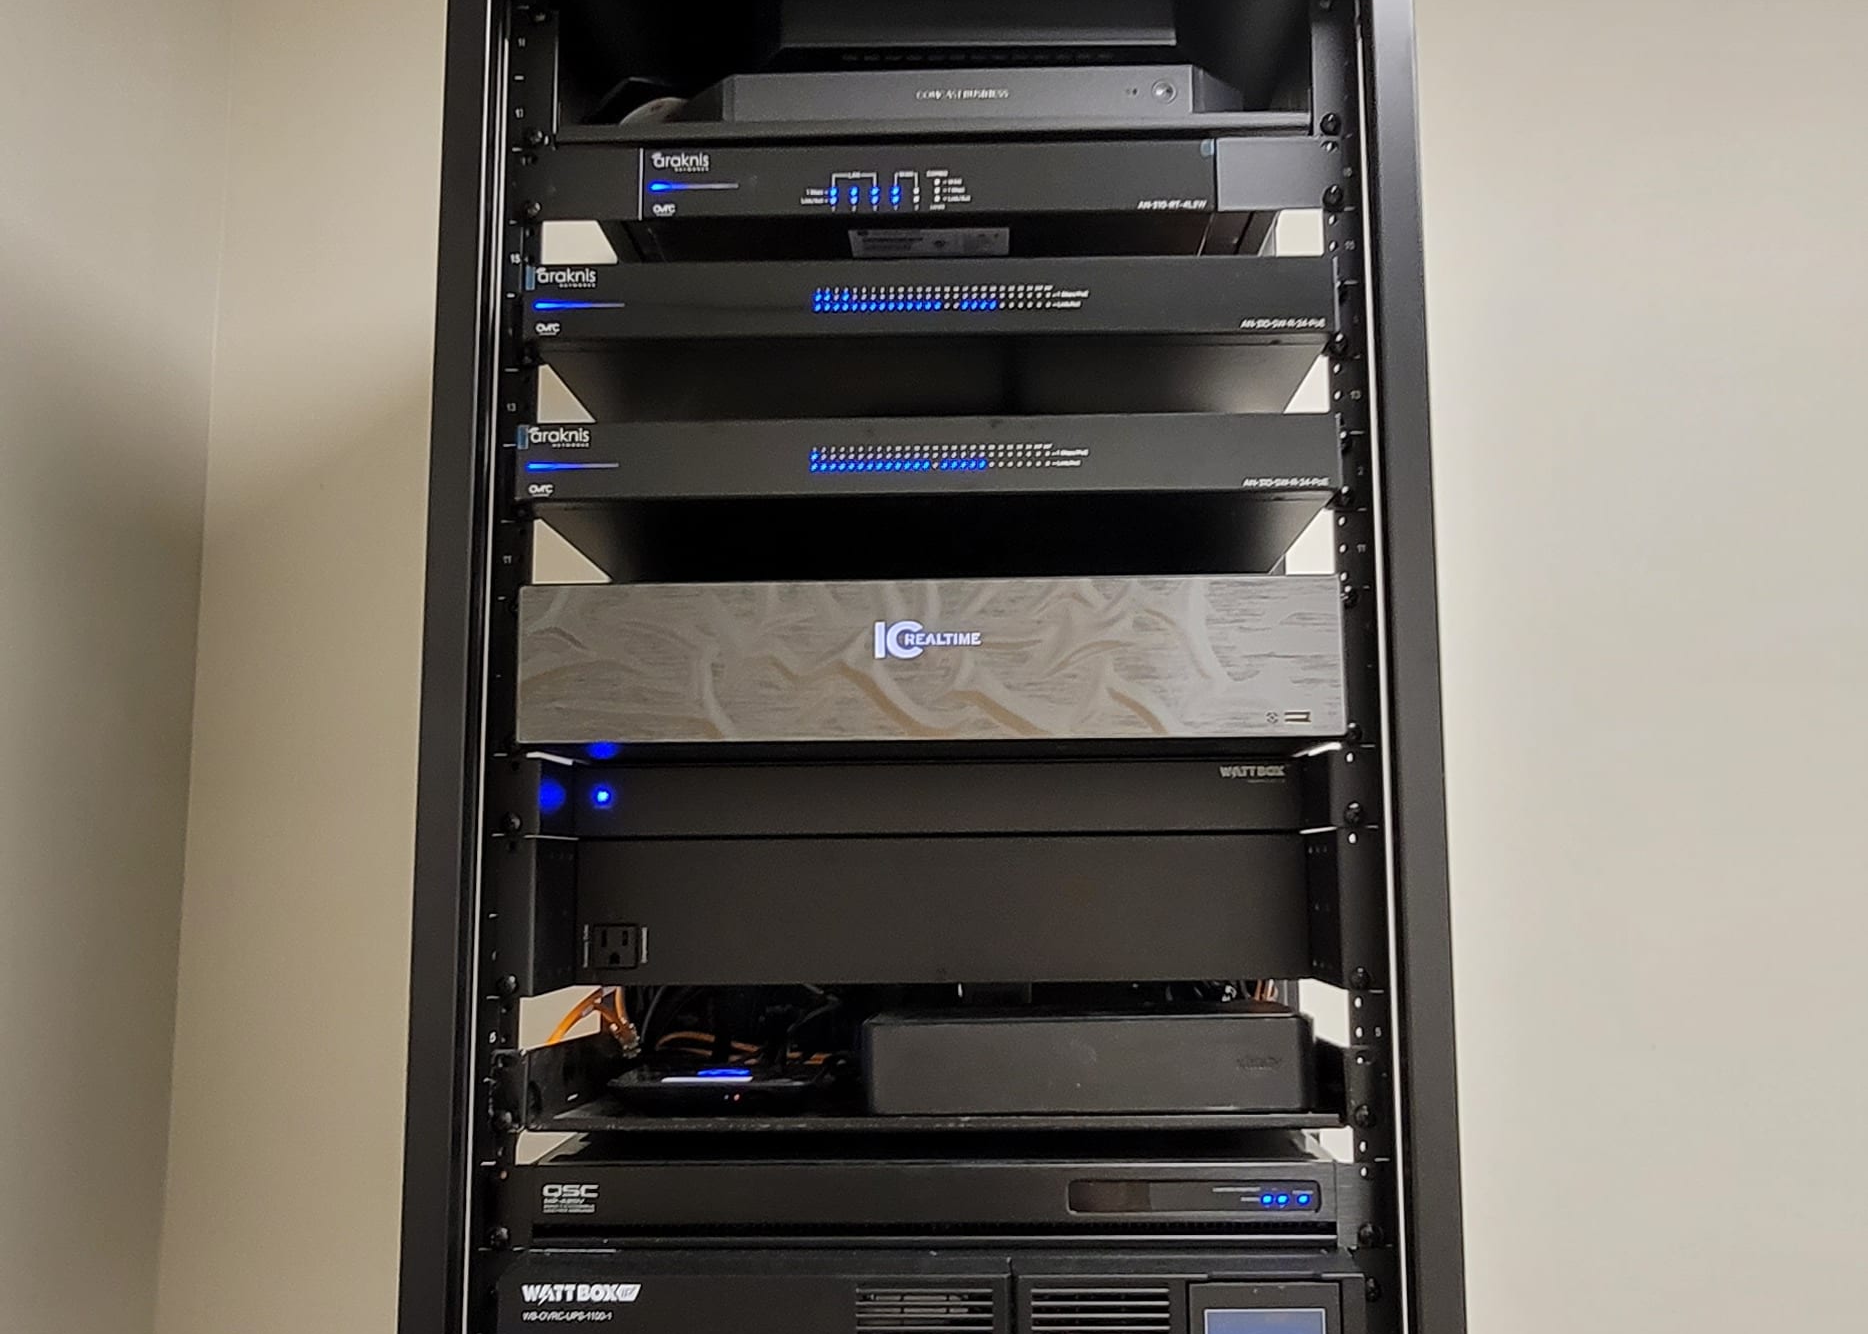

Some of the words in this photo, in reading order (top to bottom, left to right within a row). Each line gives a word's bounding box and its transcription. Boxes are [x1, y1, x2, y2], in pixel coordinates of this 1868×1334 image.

[536, 267, 597, 284] araknis
[528, 427, 590, 443] araknis
[875, 621, 924, 659] IC
[904, 632, 982, 646] REALTIME
[542, 1184, 600, 1198] QSC
[521, 1283, 619, 1306] WATTBOX
